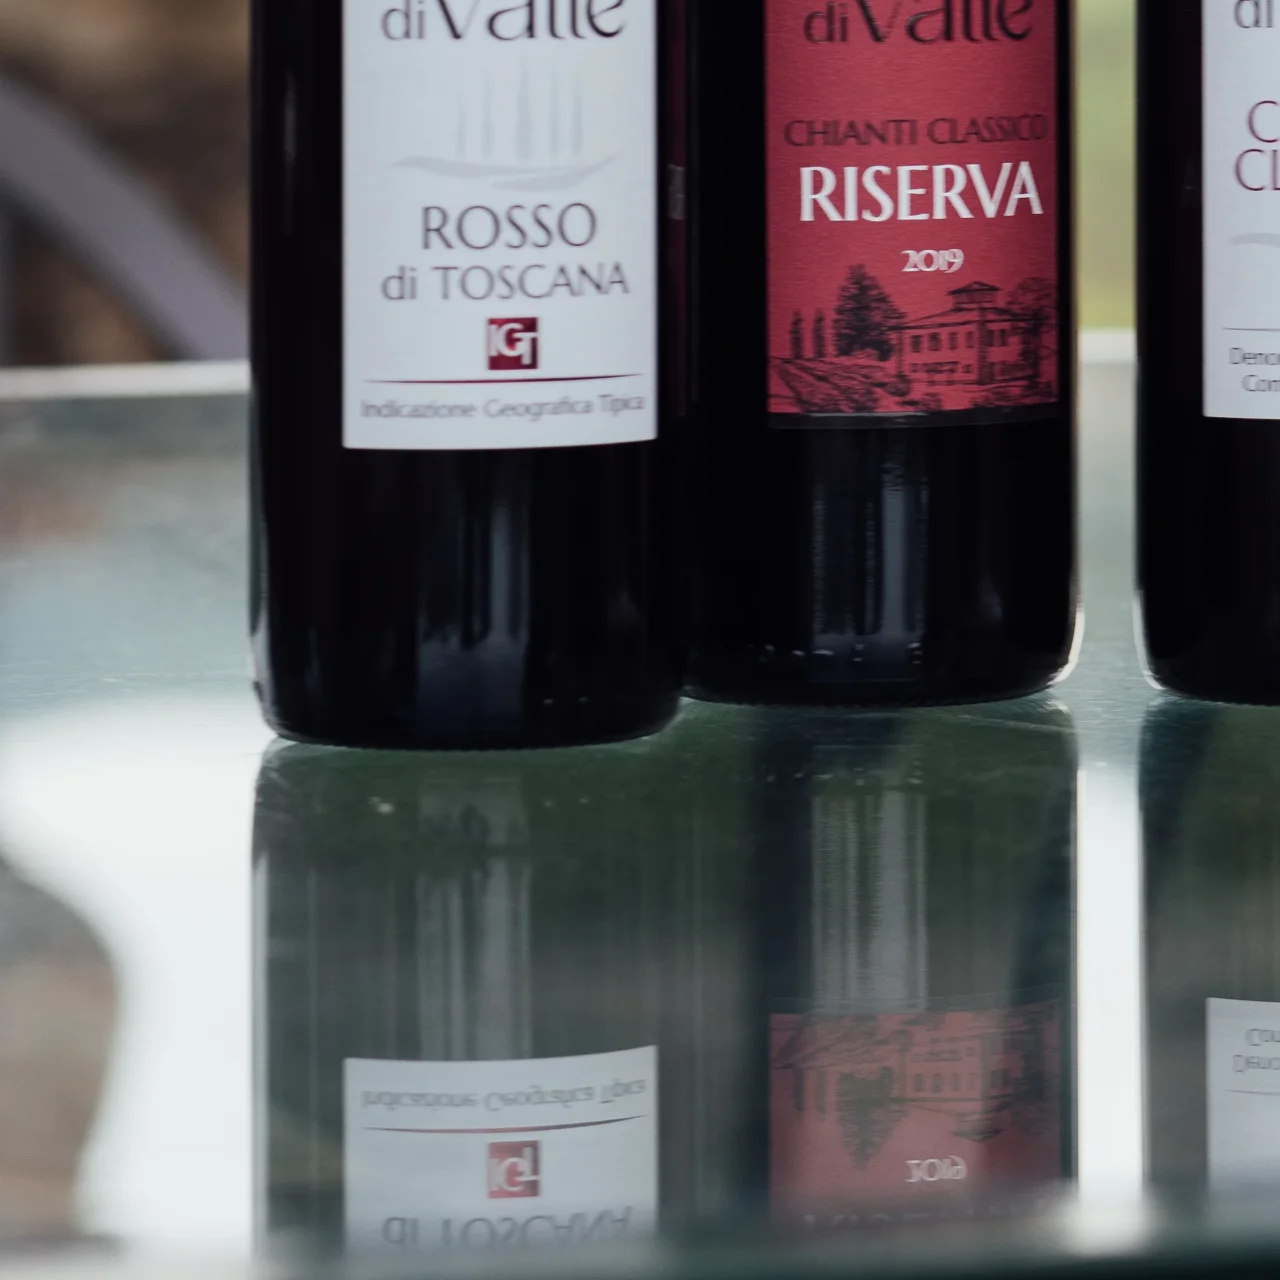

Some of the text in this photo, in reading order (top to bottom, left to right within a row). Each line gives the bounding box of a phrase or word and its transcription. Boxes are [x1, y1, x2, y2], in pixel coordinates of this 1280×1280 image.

[784, 114, 1048, 147] CHIANTI CLASSICO
[800, 161, 1044, 222] RISERVA
[421, 202, 597, 250] ROSSO
[900, 248, 965, 273] 2019
[381, 261, 631, 300] di TOSCANA
[488, 322, 538, 365] IGT
[361, 393, 645, 421] Indicazione Geografica Tipica
